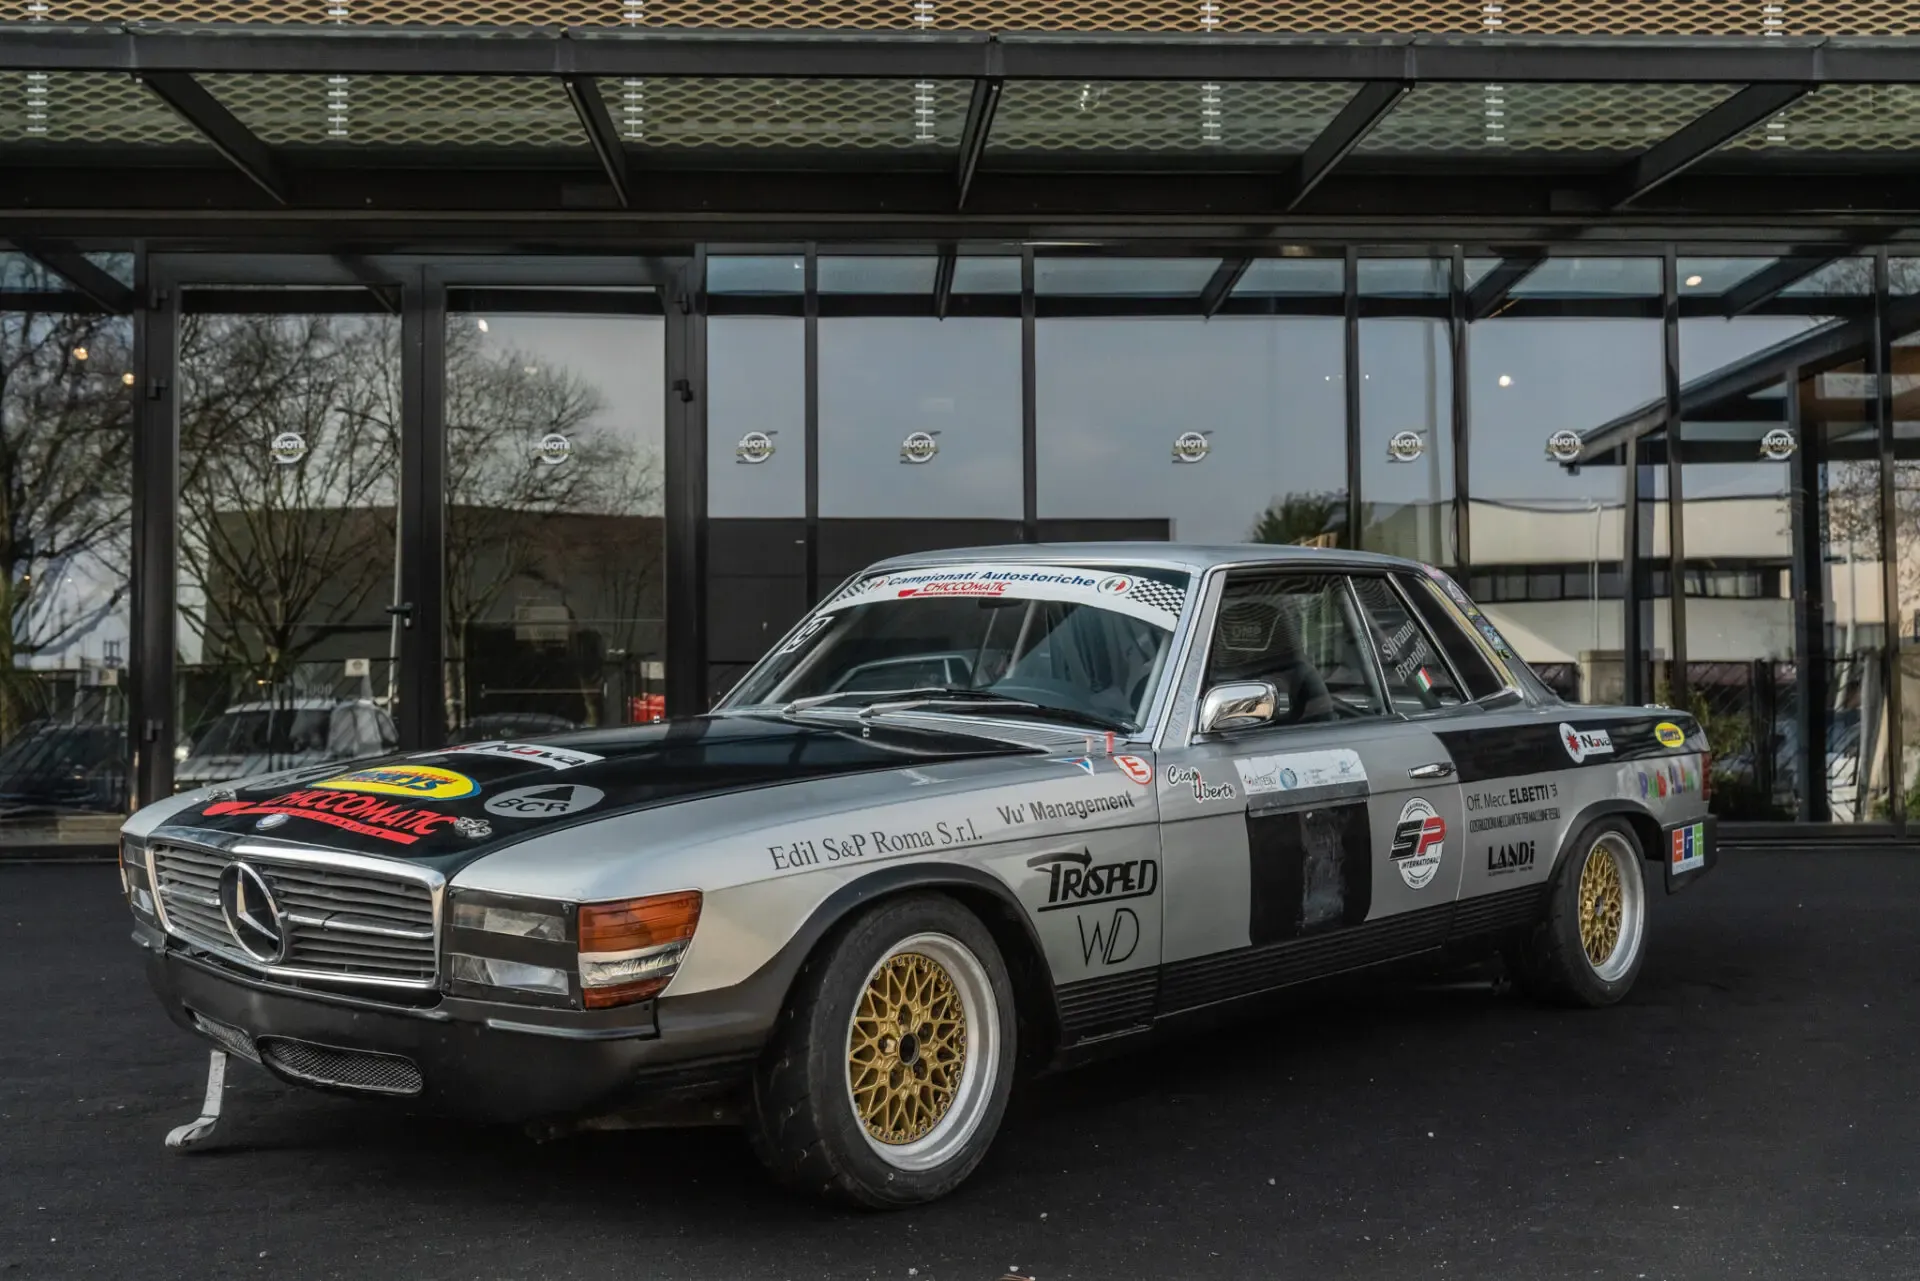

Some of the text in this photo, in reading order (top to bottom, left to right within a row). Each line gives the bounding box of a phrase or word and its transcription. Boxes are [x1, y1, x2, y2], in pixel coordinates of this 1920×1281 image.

[888, 571, 1095, 587] Campionati Autostoriche
[923, 581, 1011, 592] CHICCOMATIC
[1382, 620, 1415, 660] Silvano
[1395, 638, 1427, 682] Brandi
[1580, 734, 1611, 748] Nova
[259, 789, 456, 835] CHICCOMATIC
[492, 797, 571, 813] BCR
[1028, 790, 1135, 822] Management
[1467, 793, 1483, 811] Off.
[1509, 784, 1549, 804] ELBETTI
[768, 818, 983, 871] Edil S&P Roma S.r.l.
[1389, 816, 1447, 861] SP
[1040, 859, 1158, 903] TRASPED
[1401, 857, 1440, 870] INTERNATIONAL
[1077, 907, 1141, 967] WD
